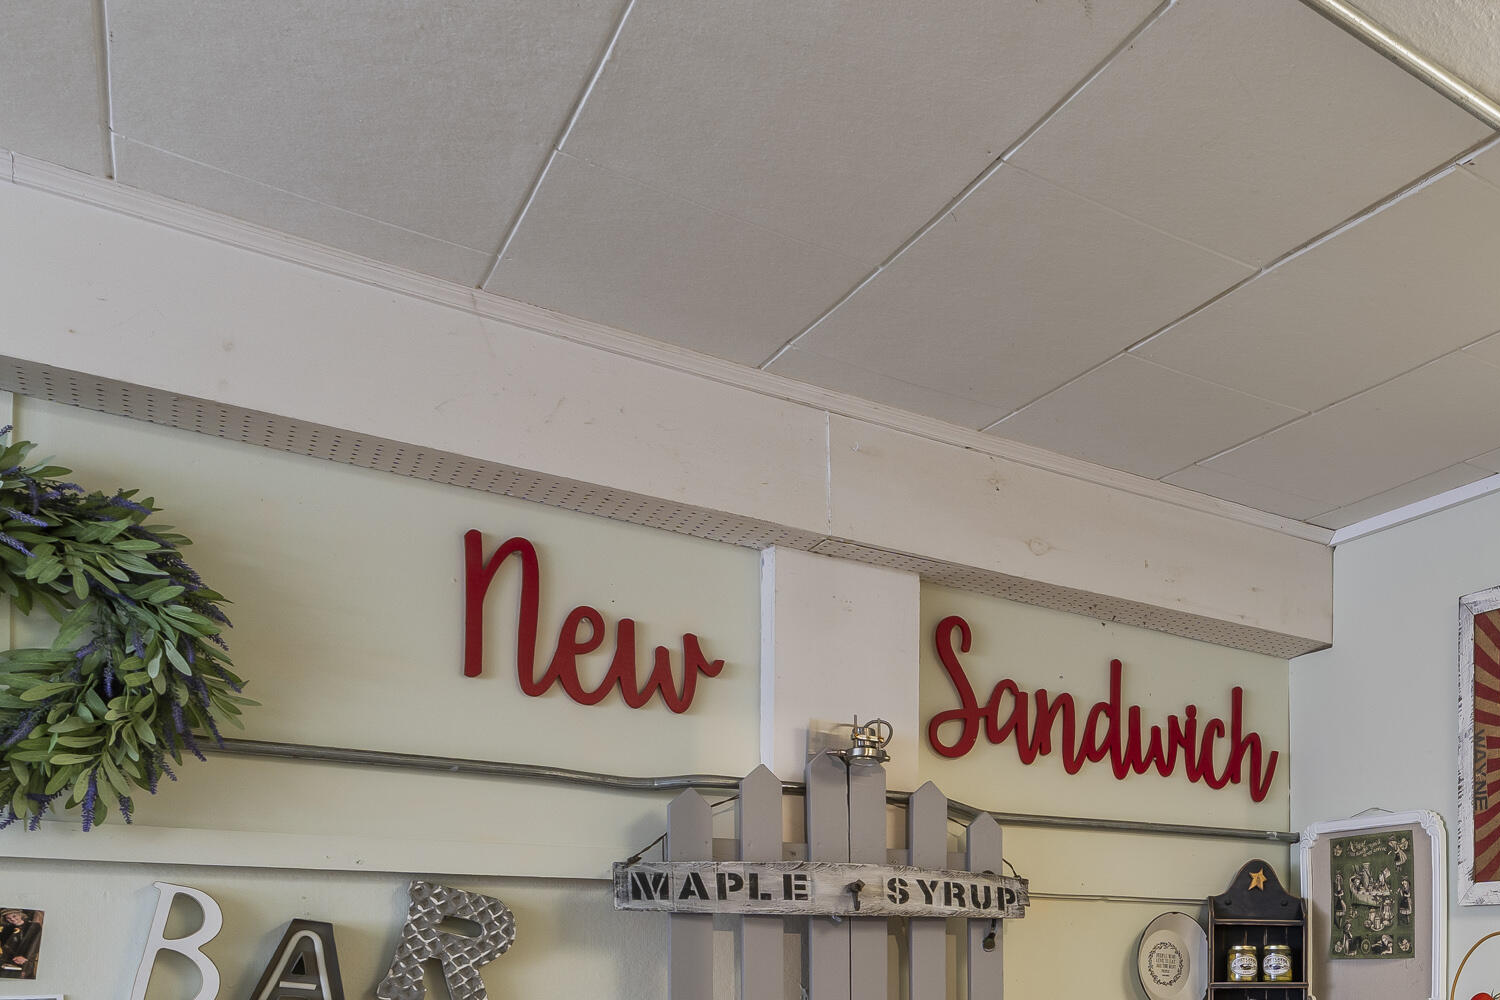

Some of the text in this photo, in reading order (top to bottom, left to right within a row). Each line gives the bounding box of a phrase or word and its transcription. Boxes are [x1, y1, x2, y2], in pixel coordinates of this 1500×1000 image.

[463, 528, 725, 714] New
[928, 615, 1279, 803] Sandwich
[630, 871, 1018, 913] MAPLE SYRUP
